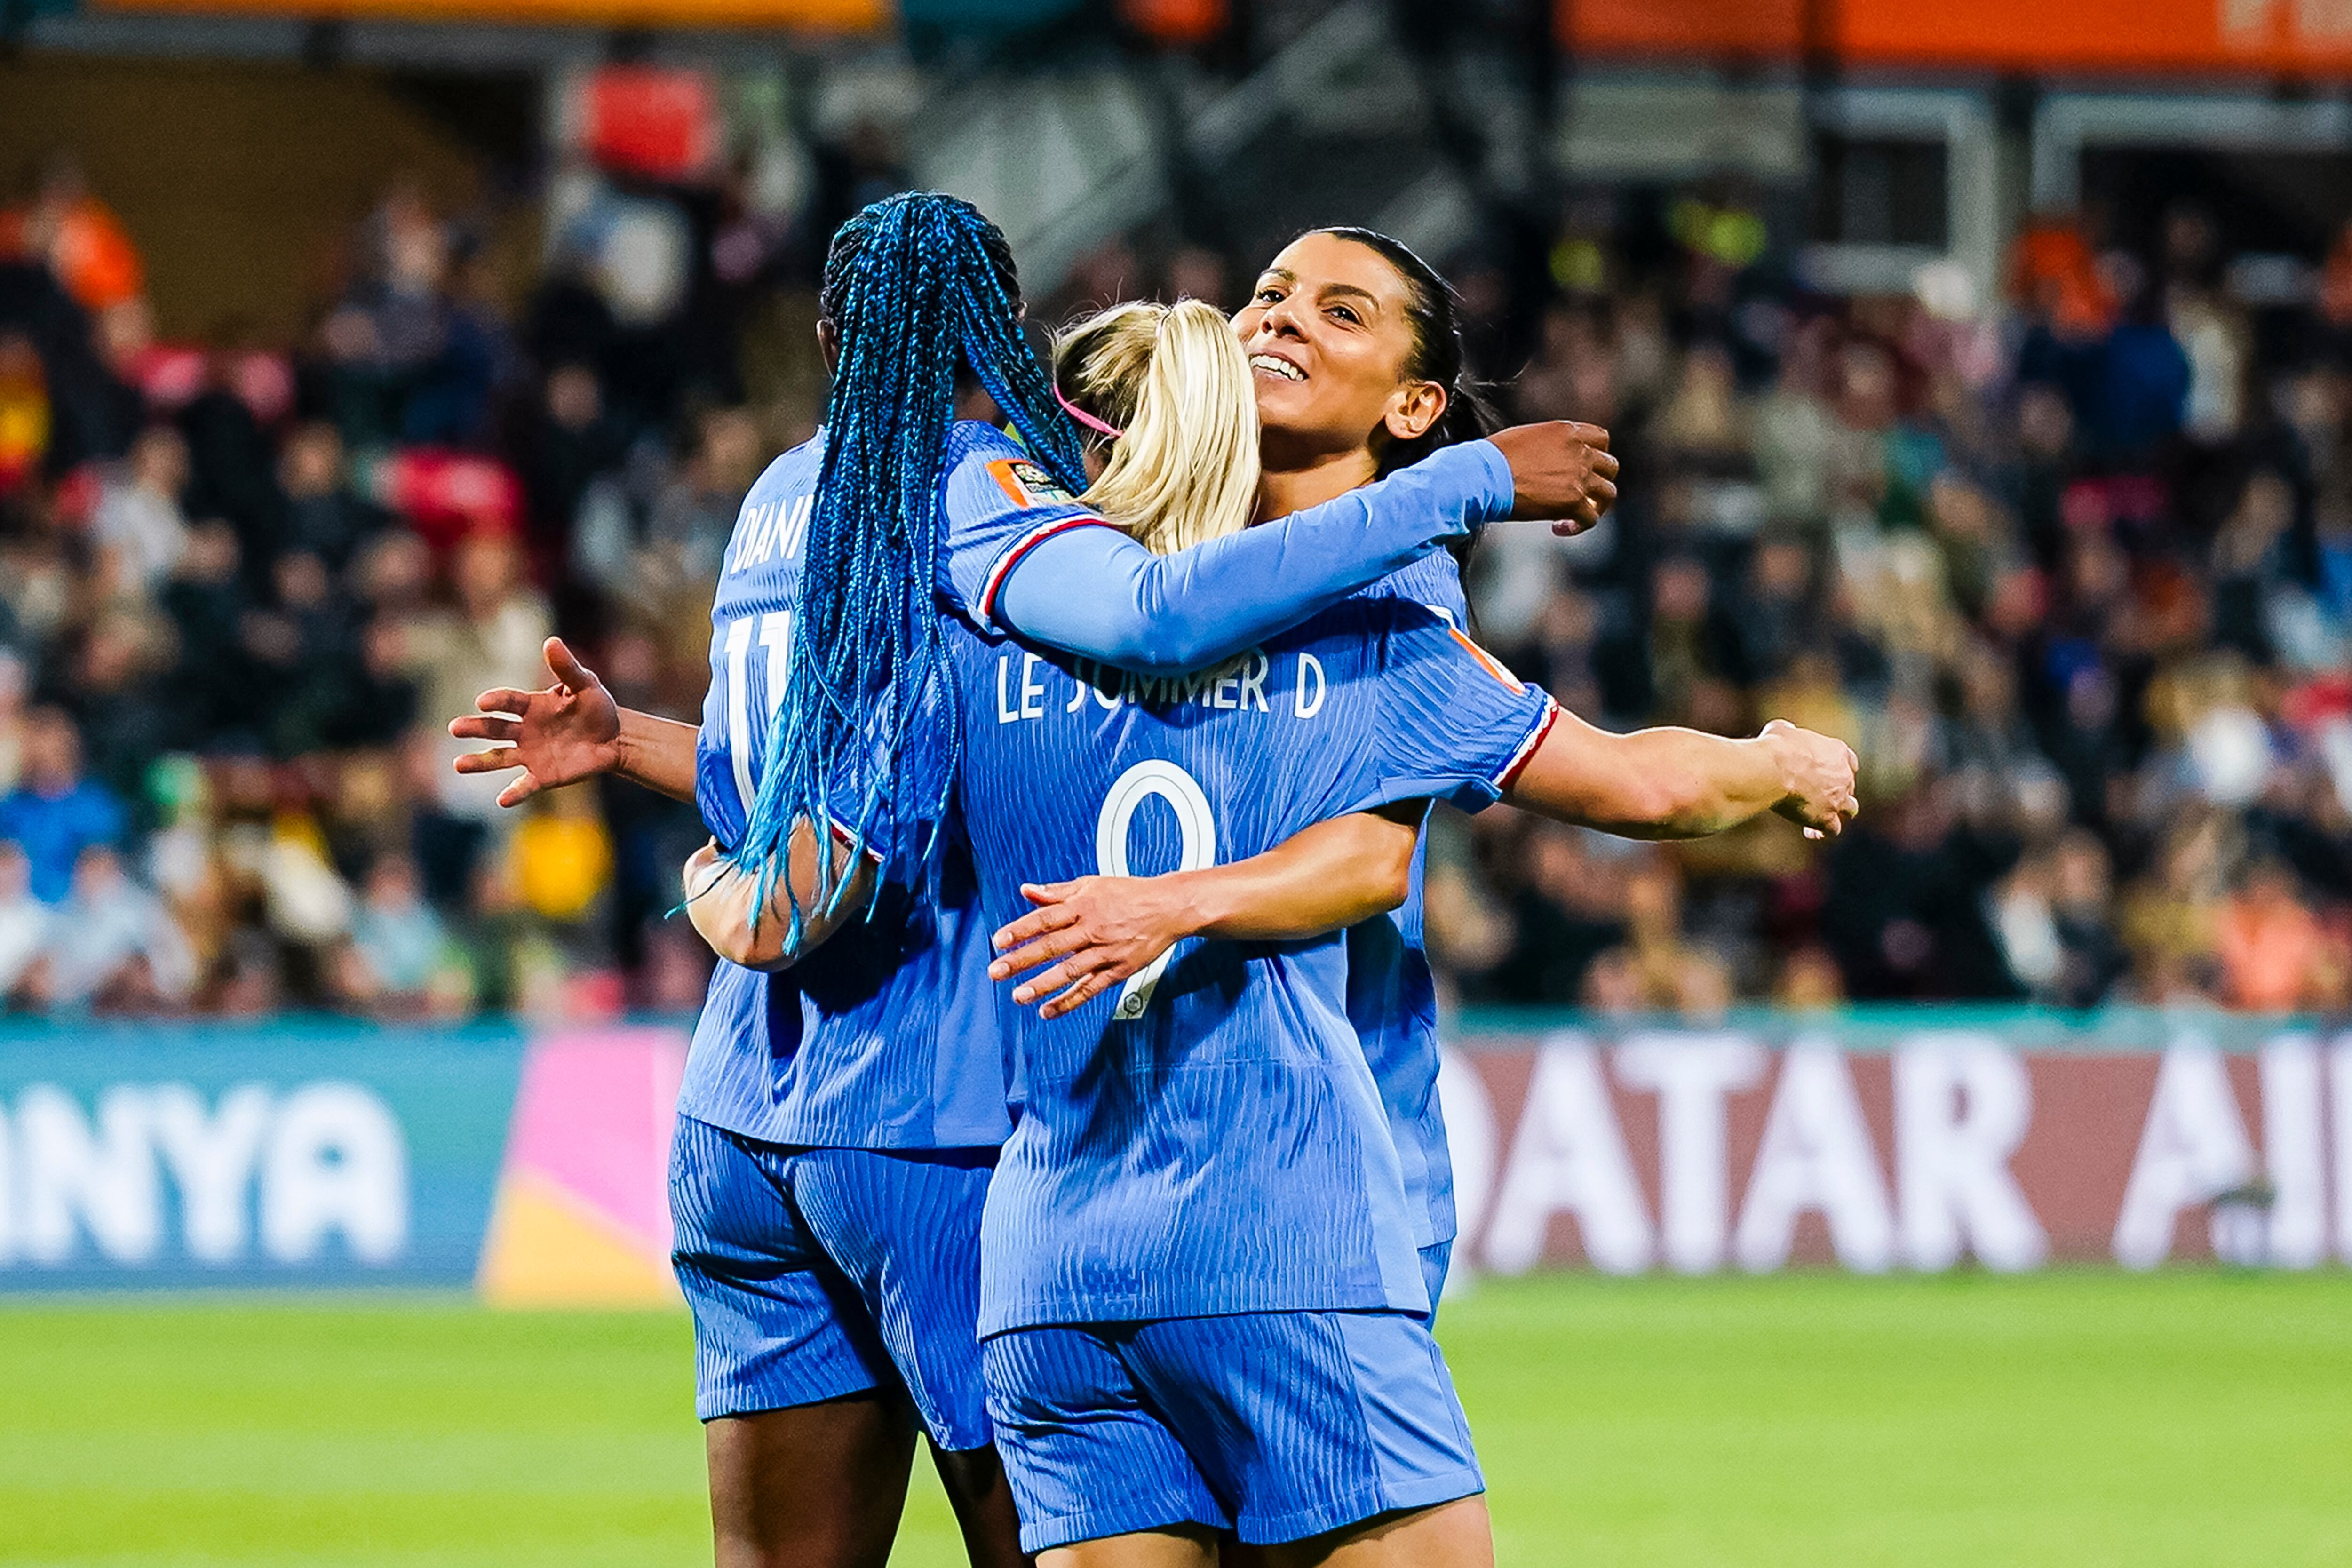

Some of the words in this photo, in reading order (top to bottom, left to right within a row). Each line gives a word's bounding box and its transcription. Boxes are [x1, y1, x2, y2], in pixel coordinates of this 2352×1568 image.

[730, 493, 814, 575] DIANI
[723, 610, 791, 821] 11
[997, 652, 1043, 724] LE
[1295, 652, 1326, 719] D
[1096, 759, 1216, 1020] 9
[0, 1082, 406, 1264] NYA
[2111, 1033, 2352, 1270] AI
